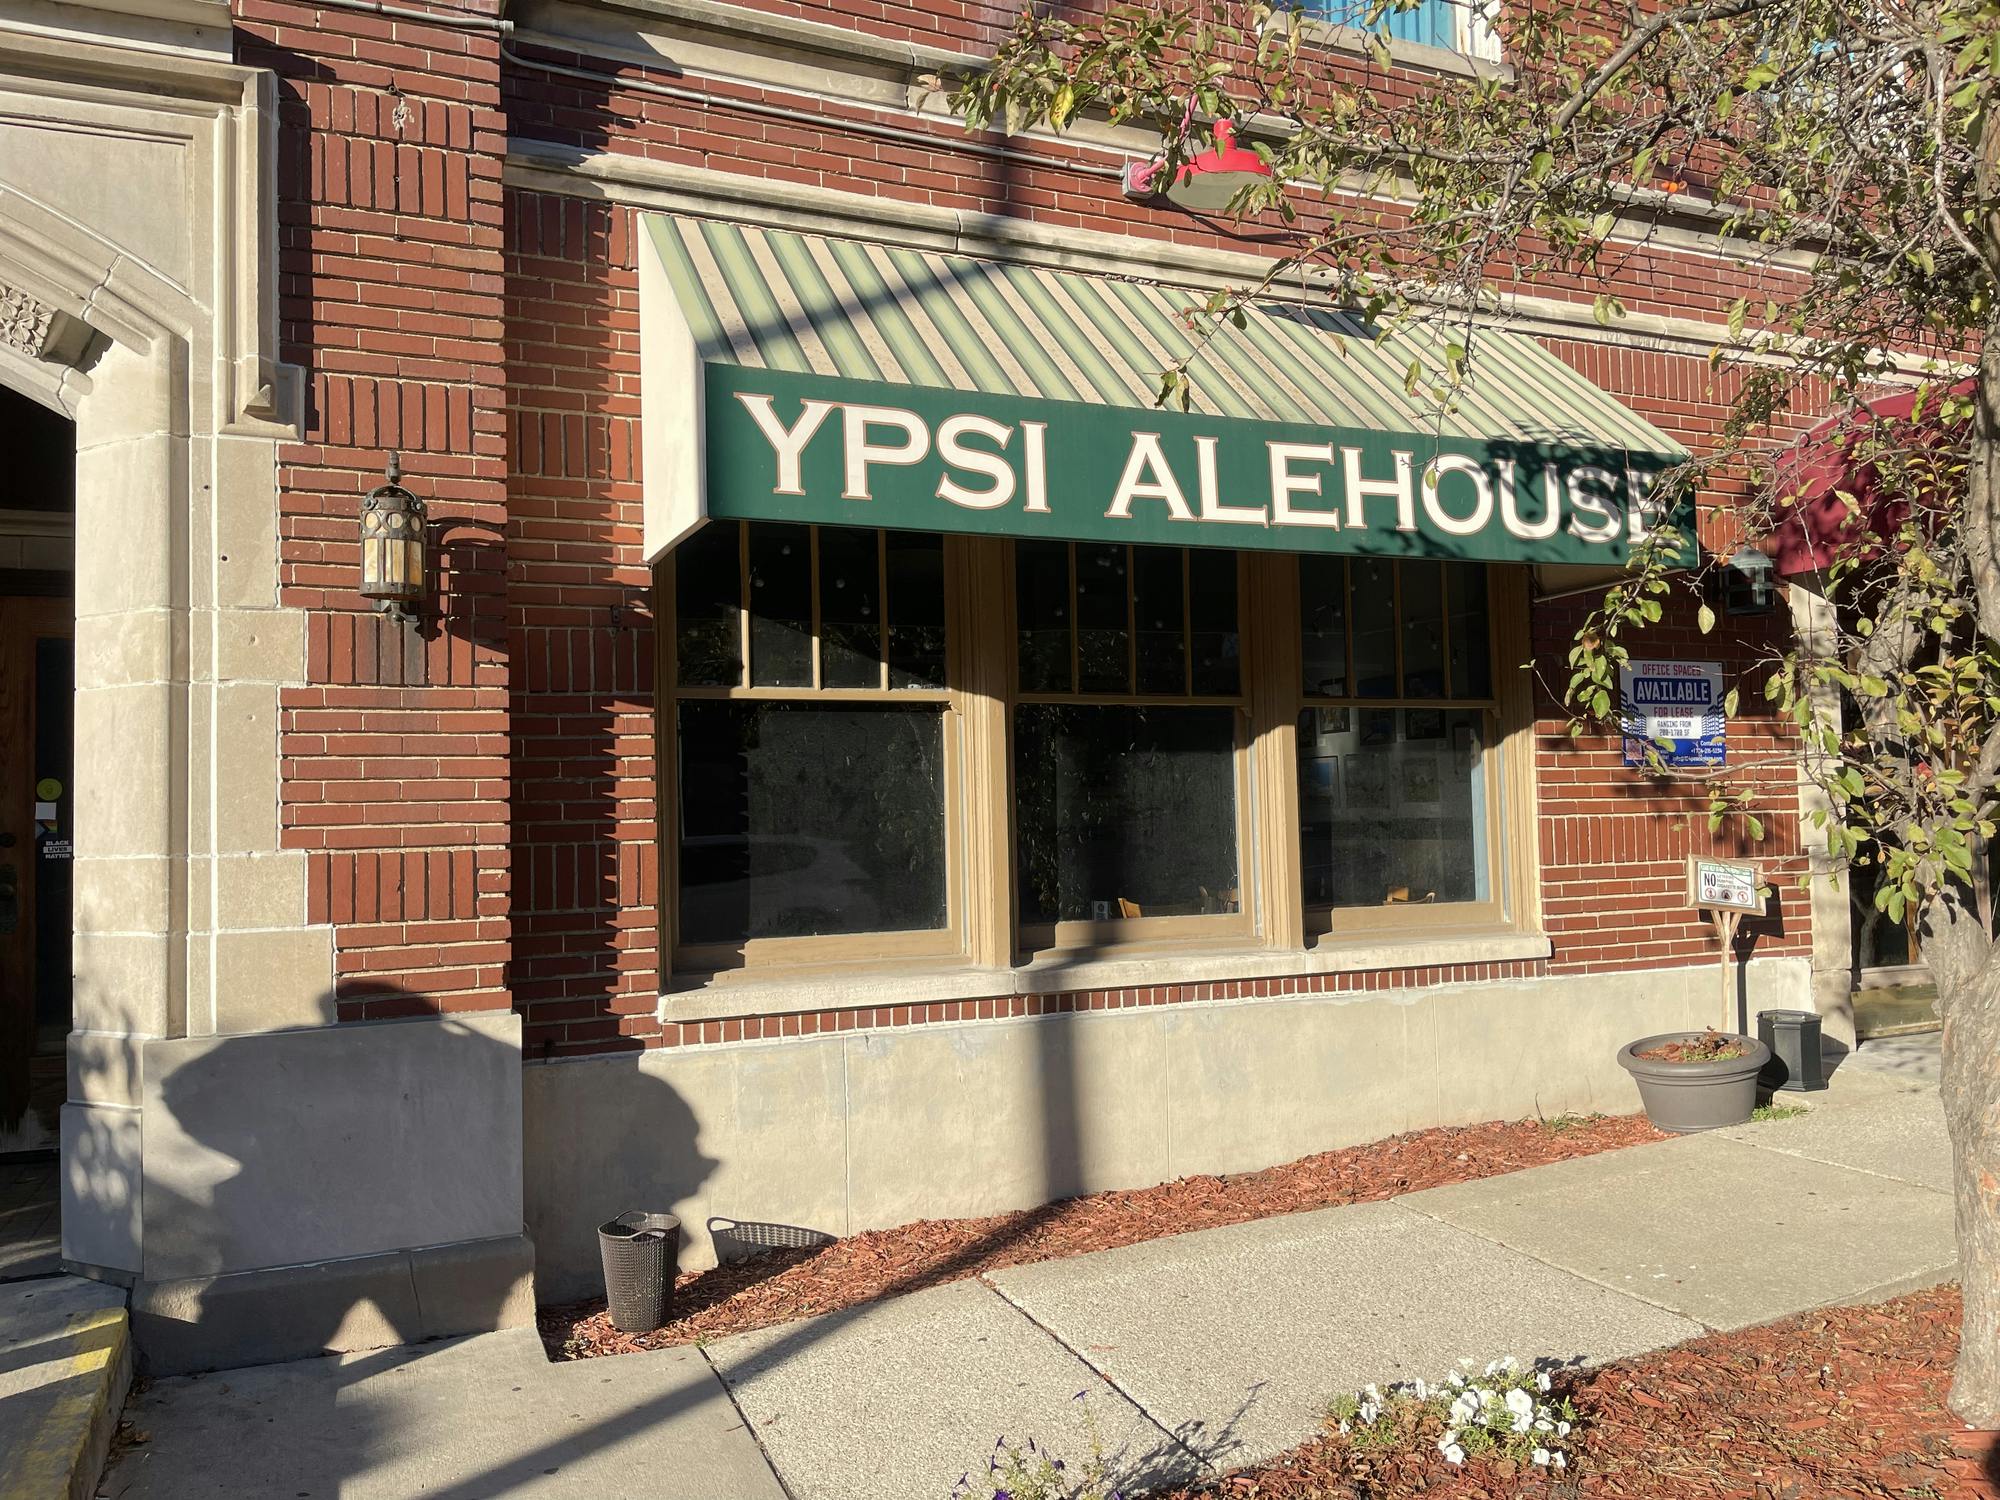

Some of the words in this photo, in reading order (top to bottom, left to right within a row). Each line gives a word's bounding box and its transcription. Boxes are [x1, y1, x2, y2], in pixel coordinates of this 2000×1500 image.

[733, 391, 1052, 511] YPSI
[1104, 431, 1686, 546] ALEHOUSE
[1642, 664, 1670, 676] OFFICE
[1673, 664, 1701, 676] SPACES
[1636, 681, 1709, 702] AVAILABLE
[1653, 706, 1668, 717] FOR
[1670, 706, 1694, 718] LEASE
[1679, 720, 1692, 728] FROM
[1704, 873, 1716, 887] NO
